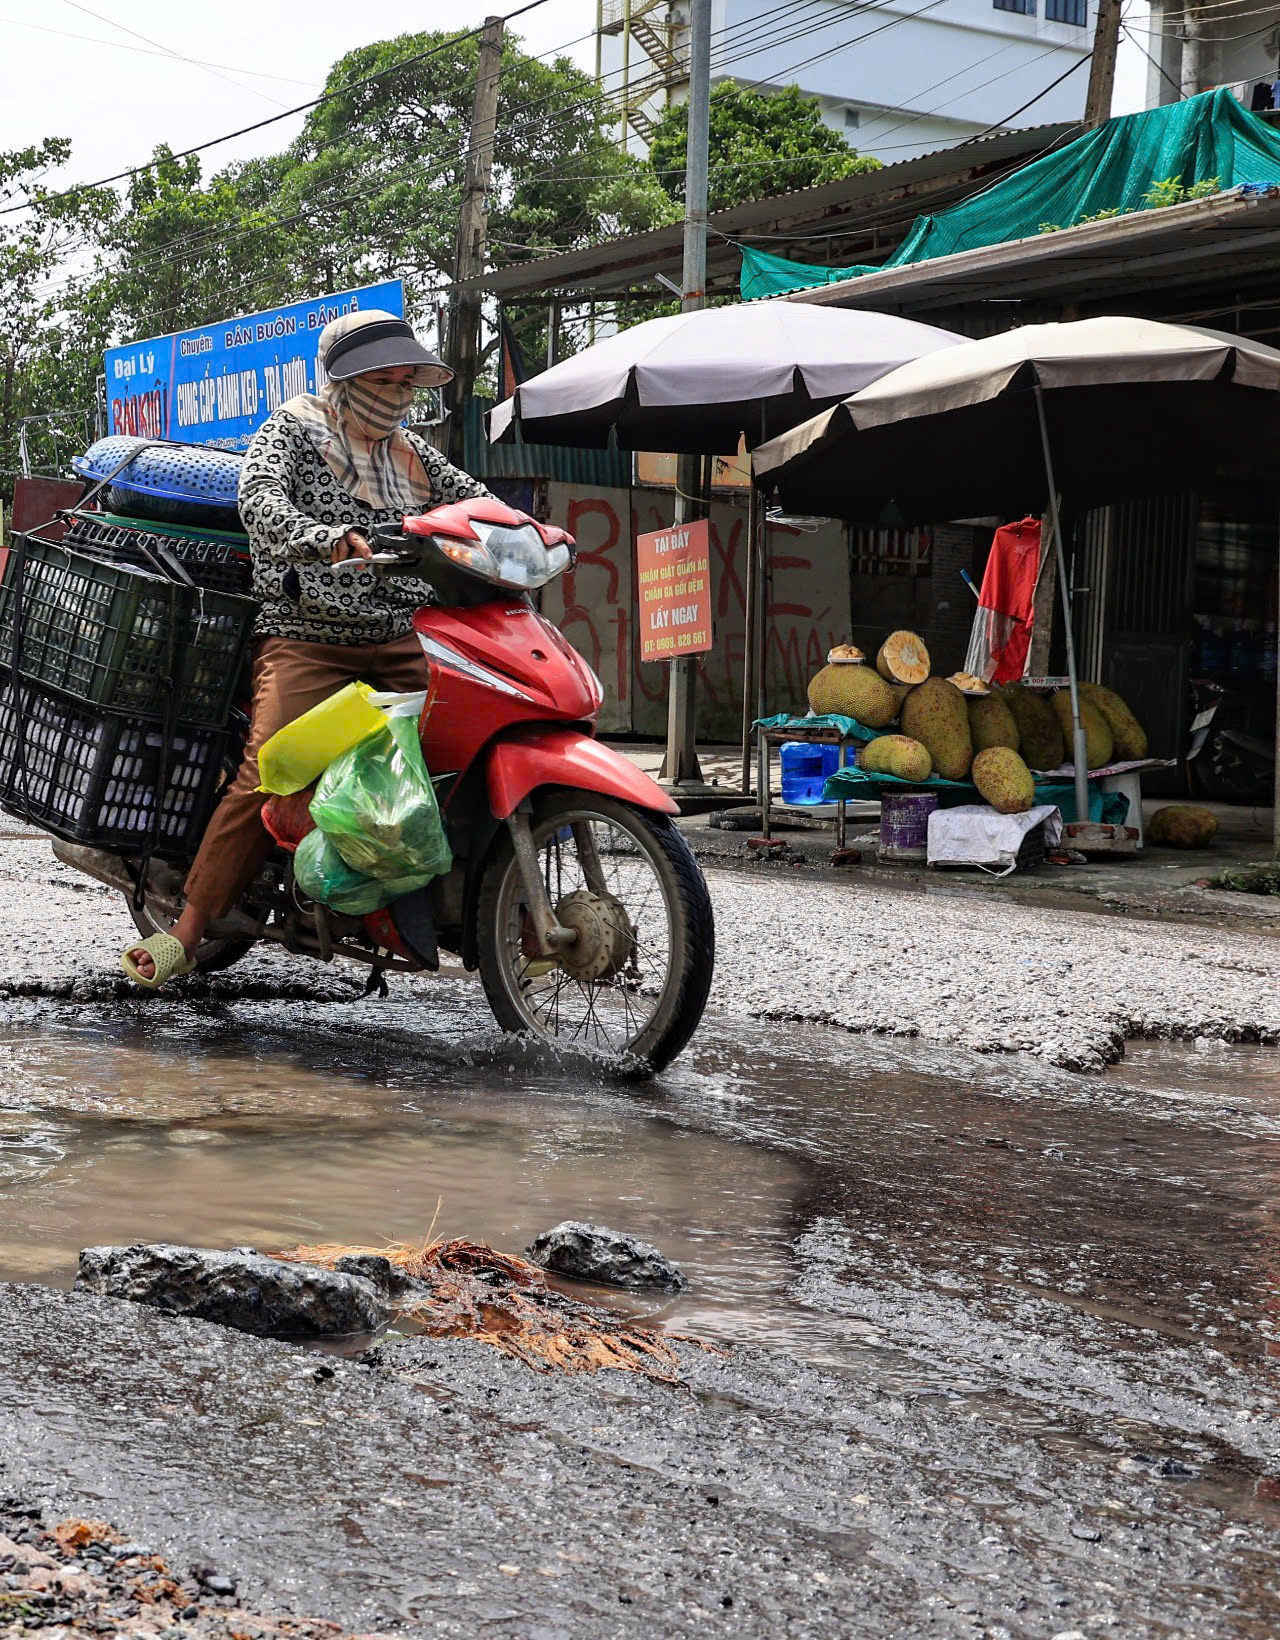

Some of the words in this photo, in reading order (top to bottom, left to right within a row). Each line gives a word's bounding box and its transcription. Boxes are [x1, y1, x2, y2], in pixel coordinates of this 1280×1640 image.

[225, 325, 253, 349] BÁN
[257, 315, 296, 342] BUÔN
[307, 304, 338, 331] BÁN
[114, 356, 136, 381] Đại
[139, 351, 155, 374] Lý
[177, 382, 199, 427] CUNG
[200, 362, 216, 423] CẤP
[217, 365, 241, 420] BÁNH
[241, 368, 258, 426] KẸO
[112, 385, 138, 437] BẢO
[654, 536, 669, 556] TẠI
[671, 529, 690, 550] ĐÂY
[640, 568, 659, 585] NHẬN
[664, 584, 674, 598] GA
[675, 579, 687, 596] GỐI
[688, 577, 704, 595] ĐỆM
[504, 608, 533, 617] HON
[650, 605, 669, 630] LẤY
[671, 604, 699, 626] NGAY
[678, 632, 692, 647] 828
[692, 631, 707, 644] 661
